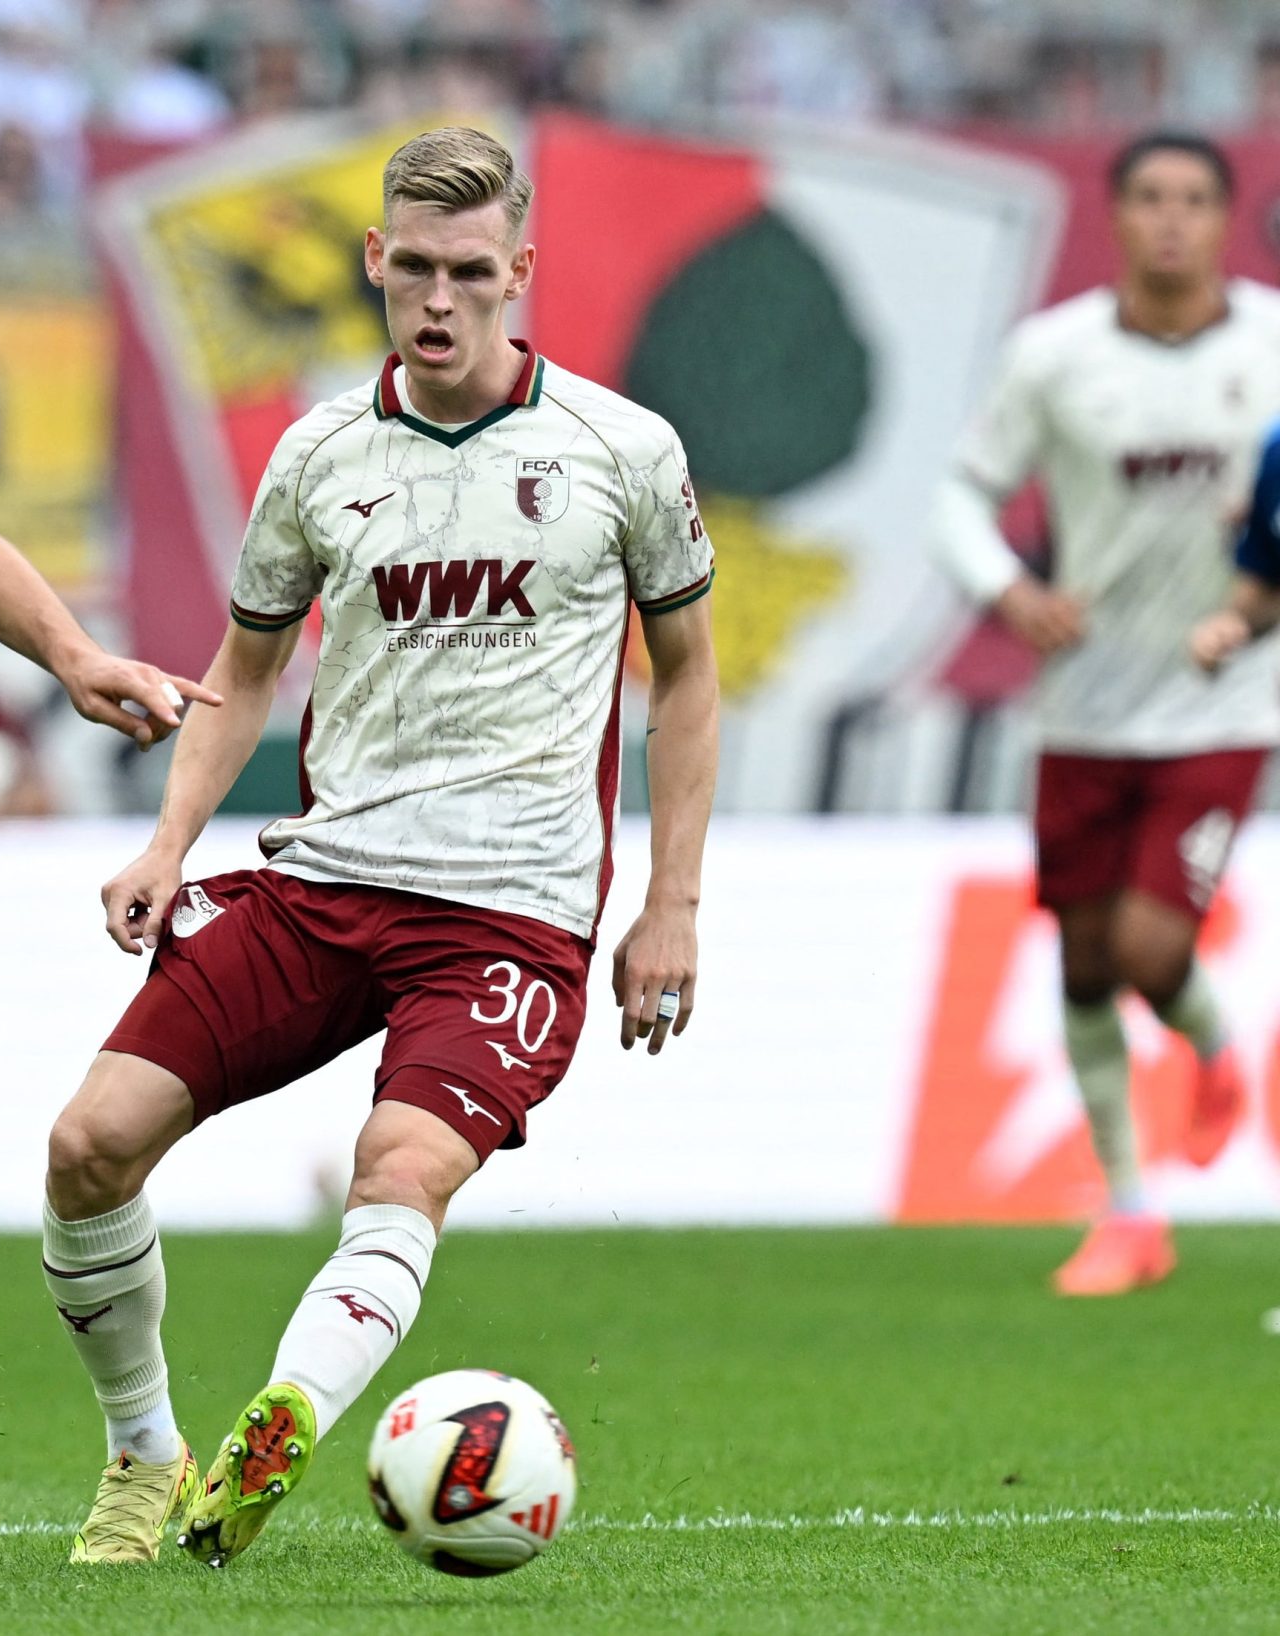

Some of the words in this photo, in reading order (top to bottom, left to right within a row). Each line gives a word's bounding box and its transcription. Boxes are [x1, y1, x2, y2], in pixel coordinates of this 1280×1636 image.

[522, 460, 564, 475] FCA
[372, 559, 537, 622] WWK
[193, 890, 218, 918] FCA
[469, 960, 557, 1053] 30
